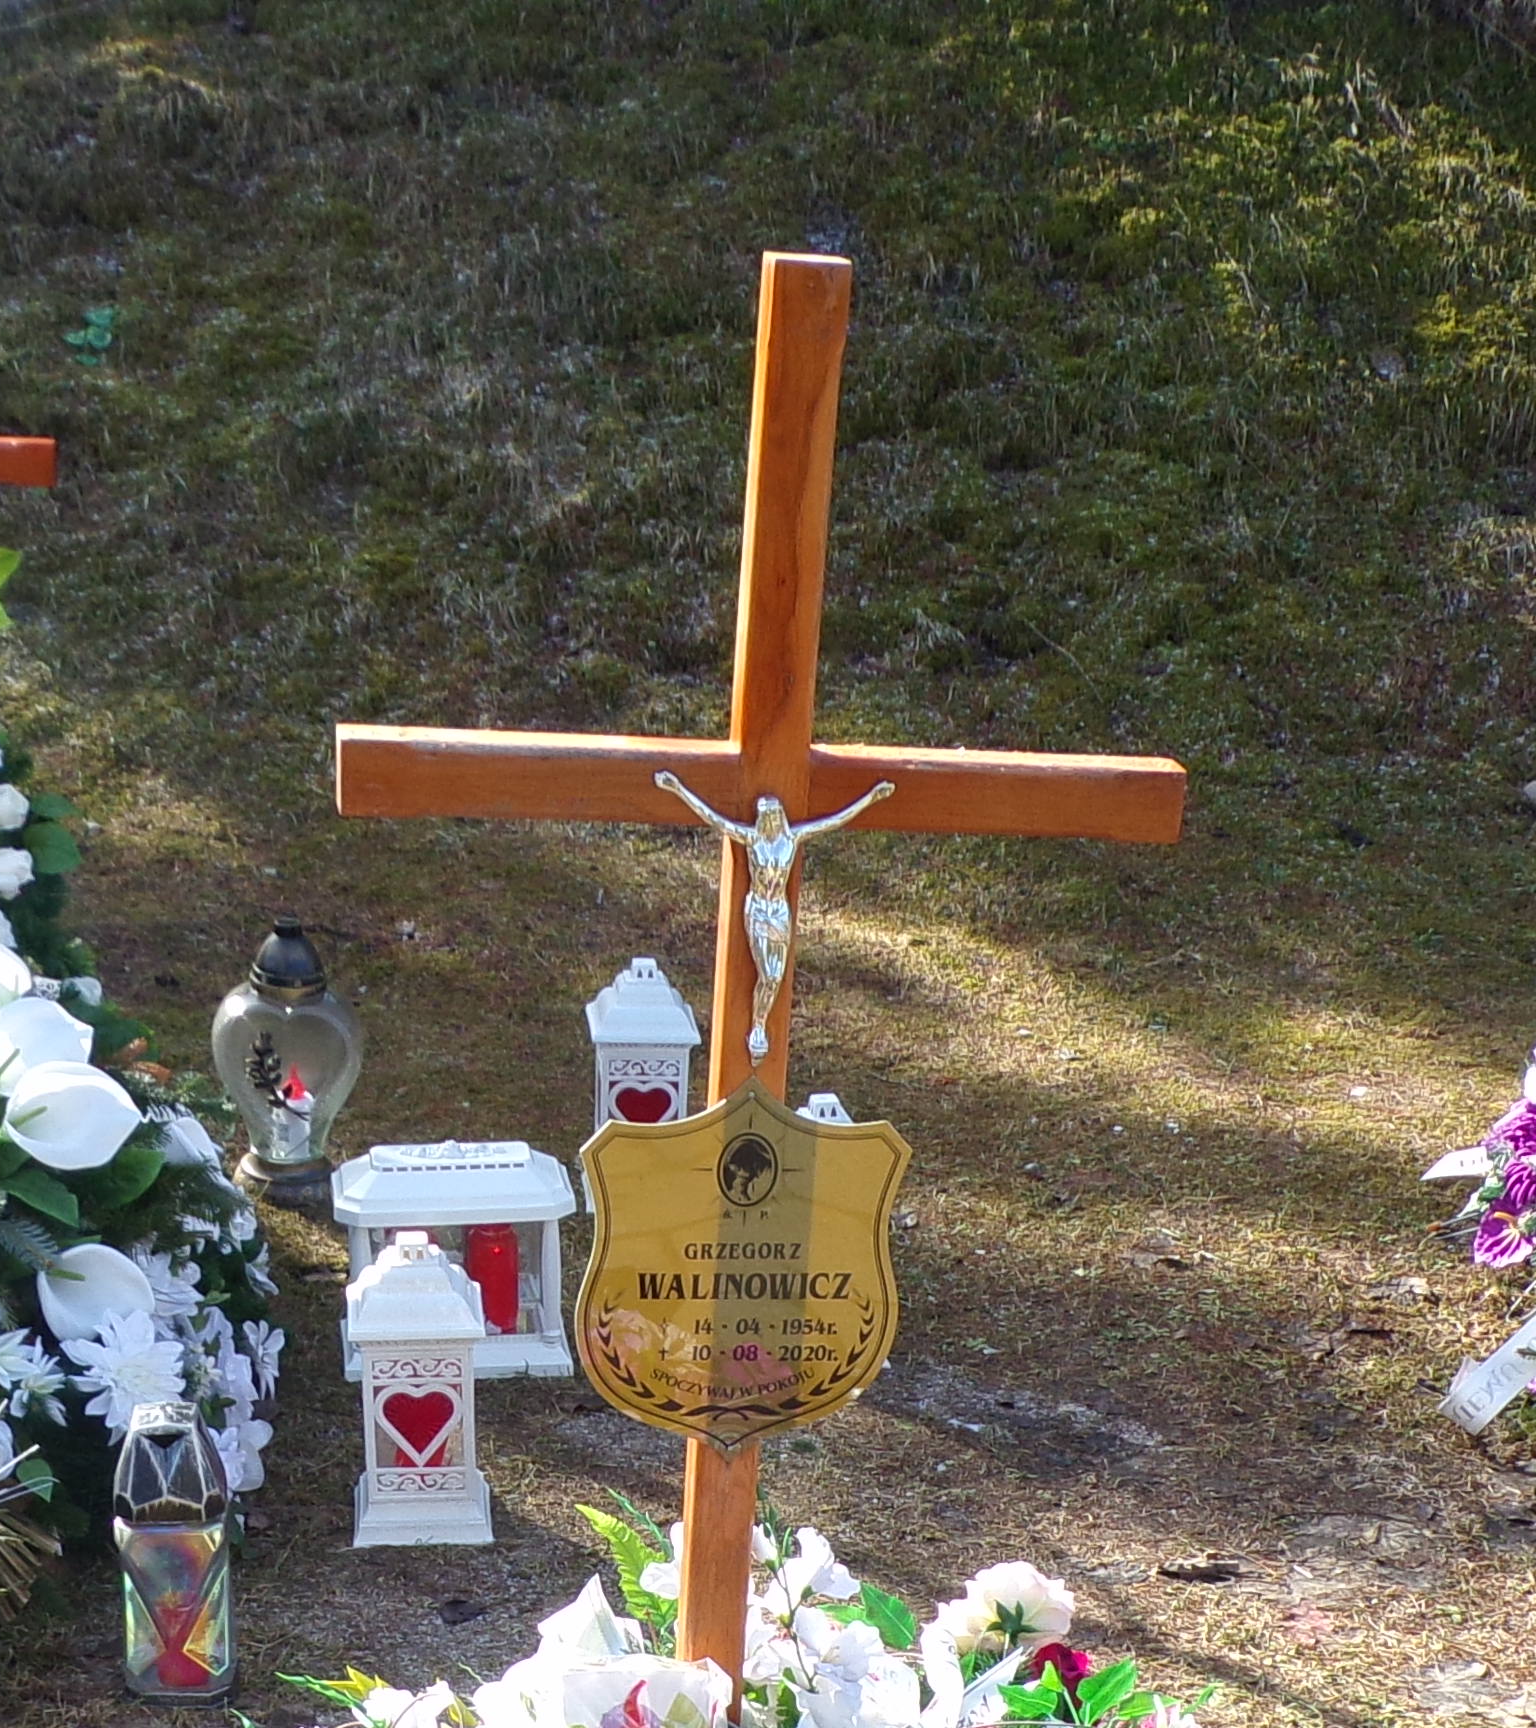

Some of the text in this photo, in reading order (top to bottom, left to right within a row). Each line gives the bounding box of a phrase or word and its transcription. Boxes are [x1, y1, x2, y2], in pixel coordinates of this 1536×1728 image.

[684, 1242, 802, 1261] GRZEGORZ
[638, 1271, 855, 1302] WALINOWICZ
[694, 1317, 715, 1336] 14
[735, 1317, 762, 1336] 04
[781, 1317, 839, 1336] 1954r.
[692, 1344, 713, 1363] 10
[732, 1344, 760, 1363] 08
[778, 1344, 840, 1363] 2020r.
[650, 1367, 816, 1400] SPOCZYWAJ W POKOJU
